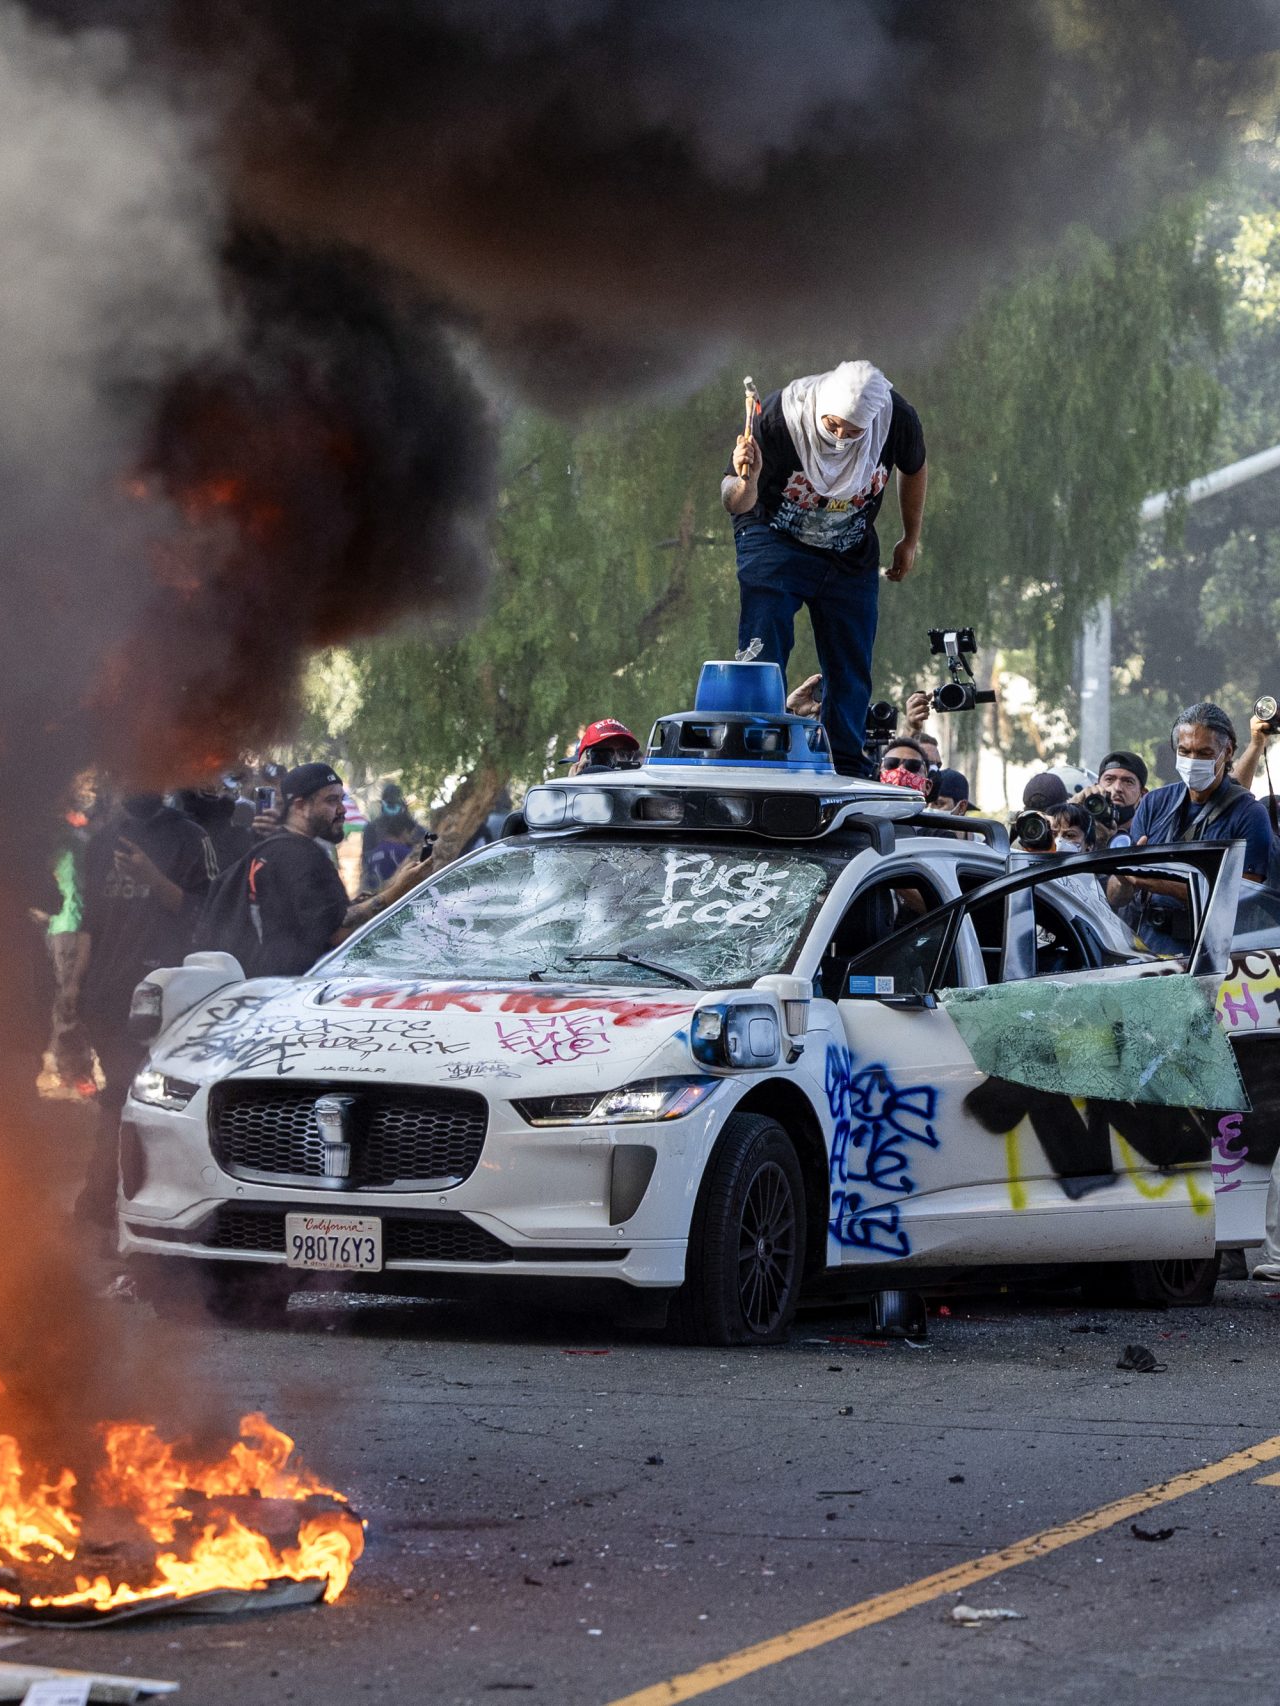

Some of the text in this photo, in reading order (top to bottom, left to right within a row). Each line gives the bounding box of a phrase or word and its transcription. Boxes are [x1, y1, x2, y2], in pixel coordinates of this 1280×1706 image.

[661, 851, 790, 904] FUCK
[357, 1019, 436, 1039] ICE
[305, 1218, 364, 1235] California
[292, 1235, 376, 1263] 98076Y3
